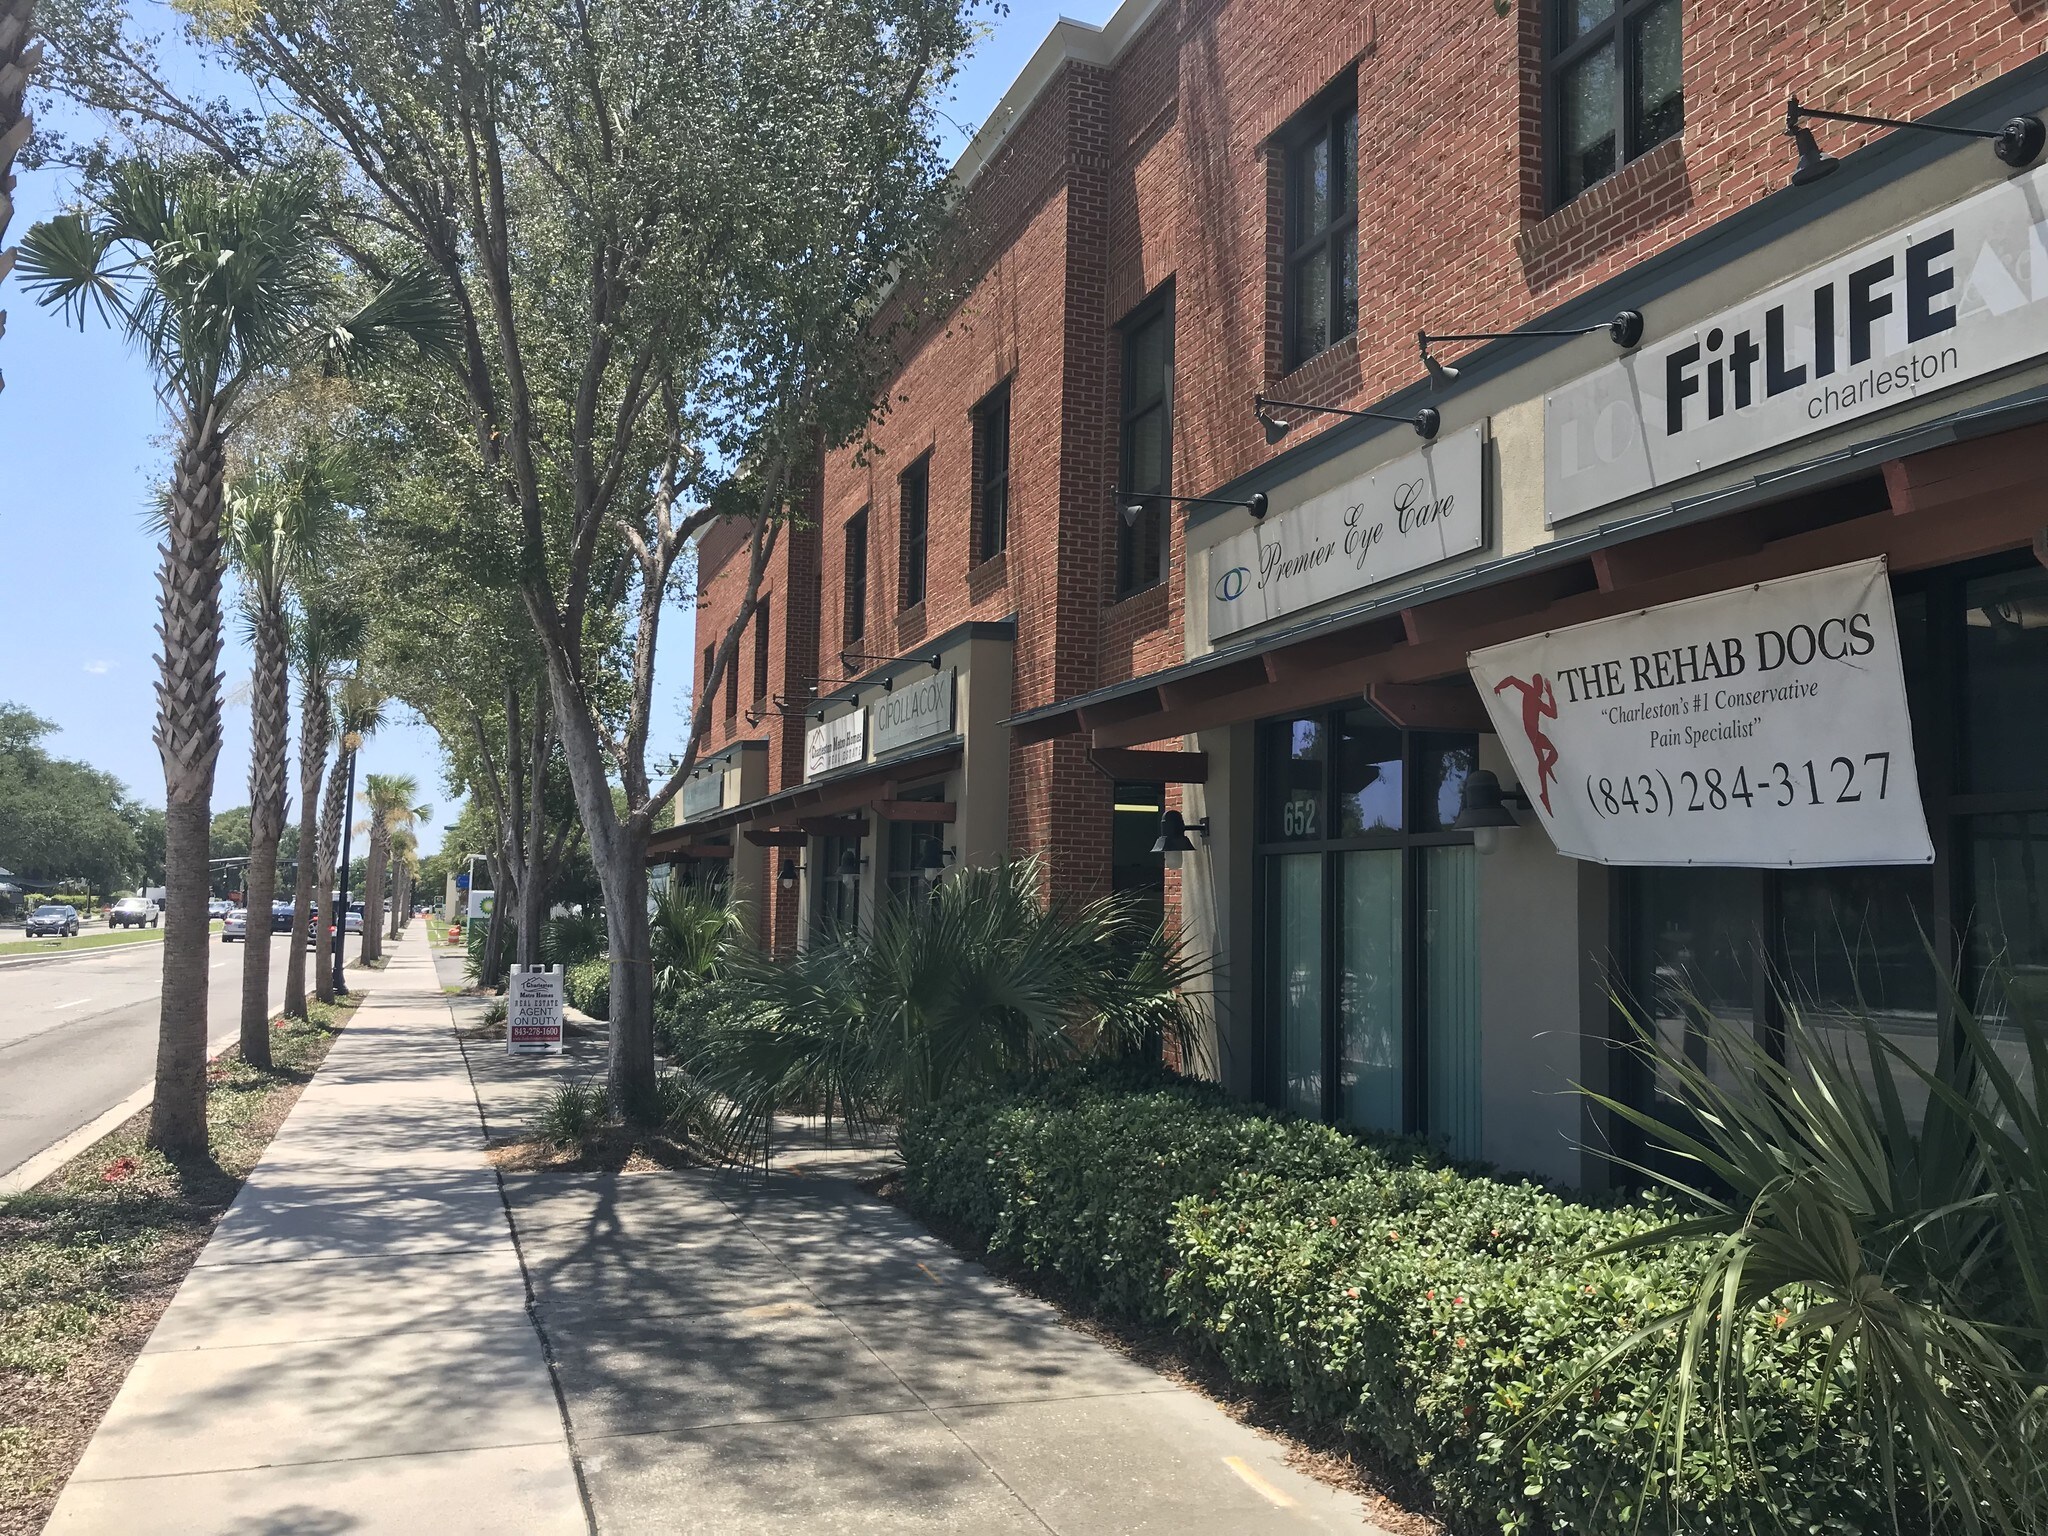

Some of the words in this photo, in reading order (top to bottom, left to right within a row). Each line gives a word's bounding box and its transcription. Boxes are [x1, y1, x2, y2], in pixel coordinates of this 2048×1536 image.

[1666, 228, 1957, 436] FitLIFE
[1807, 345, 1959, 421] charleston
[1257, 537, 1335, 590] Premier
[1343, 503, 1384, 570] Eye
[1393, 478, 1454, 535] Care
[1557, 660, 1626, 703] THE
[1630, 637, 1746, 692] REHAB
[1755, 612, 1876, 672] DOCS
[1692, 692, 1710, 713] #1
[1715, 679, 1819, 711] Conservative
[833, 736, 846, 752] Metro
[846, 731, 862, 747] Homes
[1649, 727, 1682, 748] Pain
[1684, 716, 1763, 749] Specialist”
[1283, 799, 1316, 837] 652
[515, 999, 531, 1007] REAL
[534, 999, 559, 1007] ESTATE
[519, 1007, 554, 1016] AGENT
[514, 1017, 529, 1026] ON
[531, 1016, 559, 1026] DUTY
[514, 1027, 559, 1036] 843-278-1600
